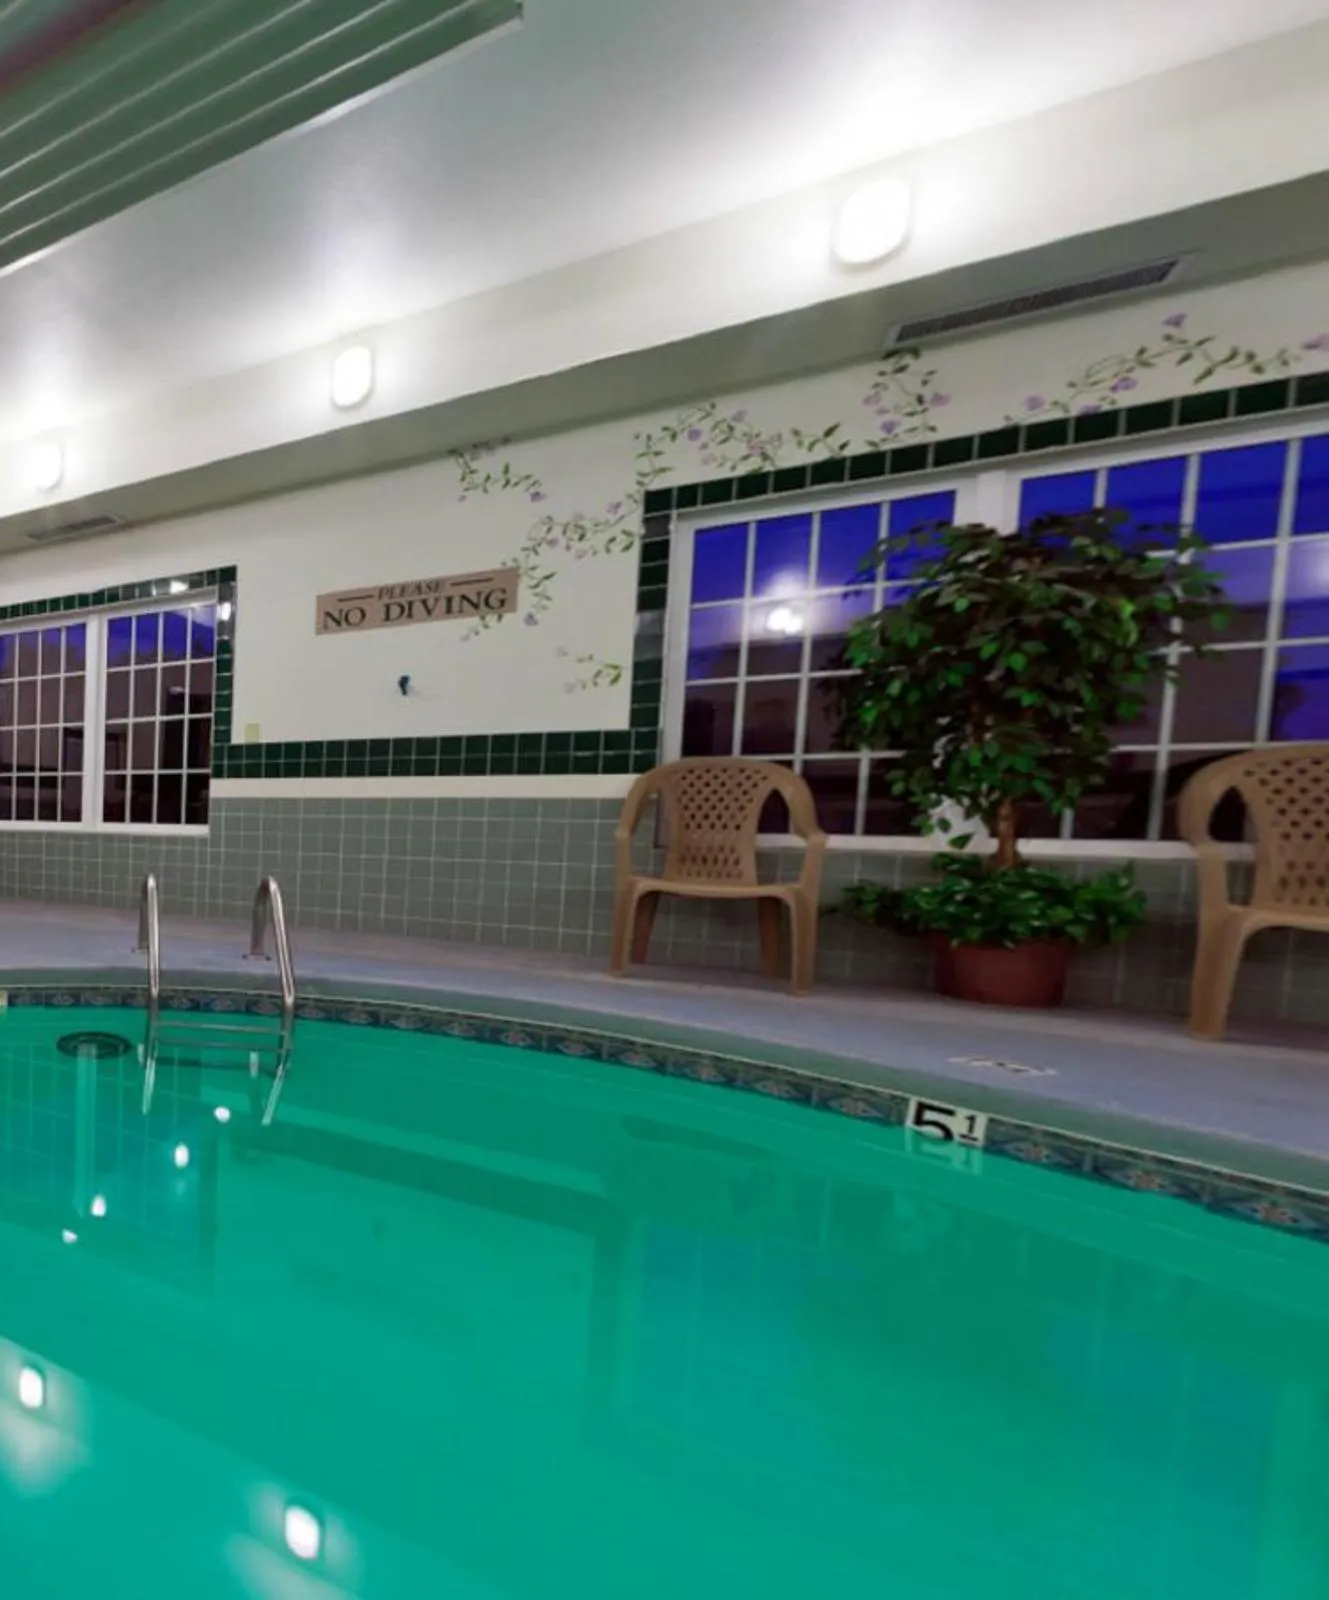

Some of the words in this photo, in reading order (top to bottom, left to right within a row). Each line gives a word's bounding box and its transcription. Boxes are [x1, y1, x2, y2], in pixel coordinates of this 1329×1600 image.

[378, 579, 441, 600] PLEASE
[323, 606, 367, 630] NO
[382, 587, 508, 622] DIVING
